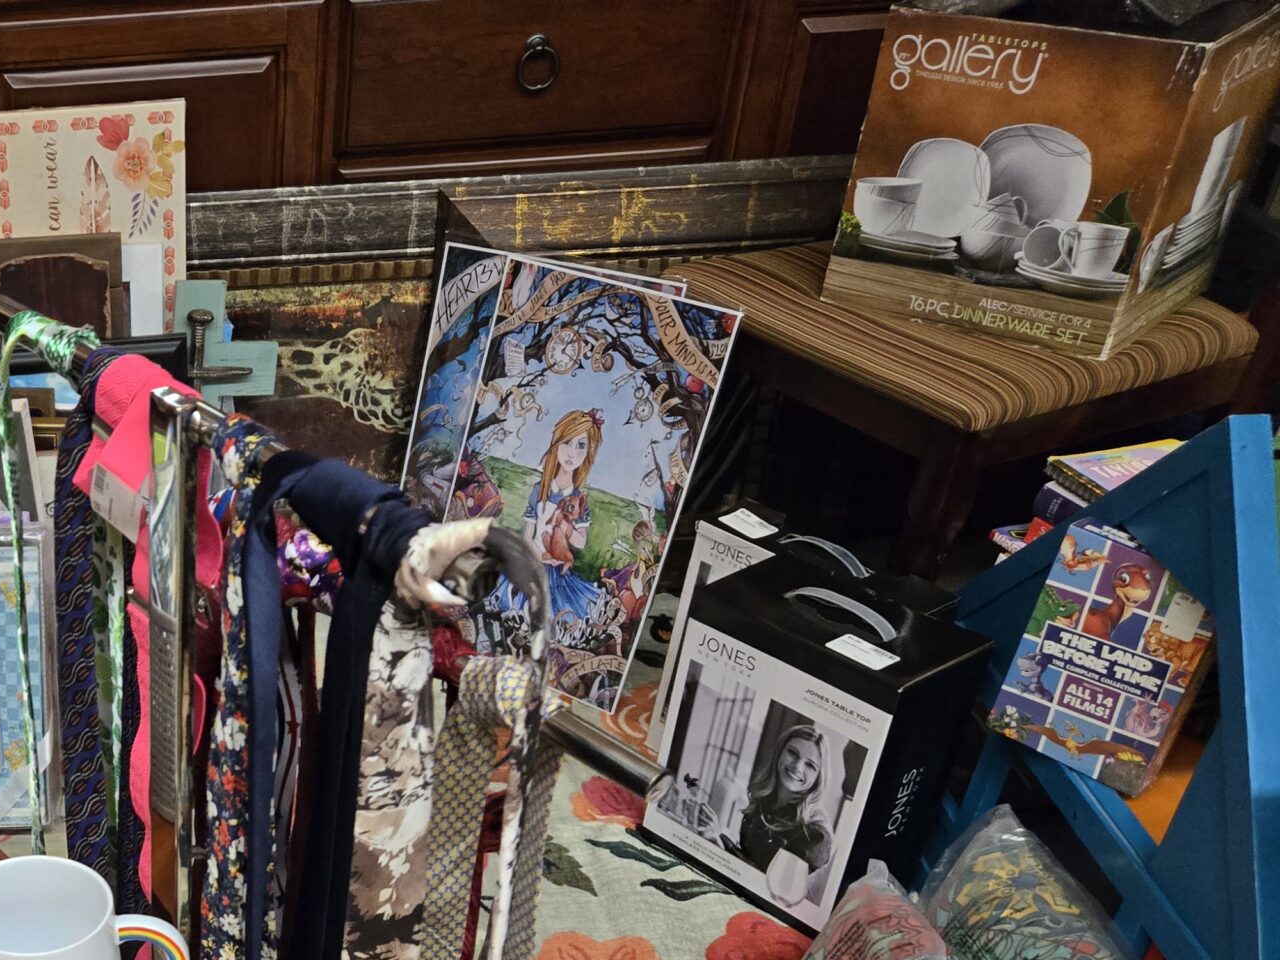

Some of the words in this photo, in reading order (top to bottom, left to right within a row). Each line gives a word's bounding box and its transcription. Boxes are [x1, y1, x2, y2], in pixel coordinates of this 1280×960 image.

[971, 33, 1048, 51] TABLETOPS
[890, 34, 1045, 95] gallery
[43, 137, 60, 191] wear
[46, 198, 63, 232] can
[1056, 328, 1088, 346] SET
[1058, 314, 1083, 328] FOR
[1083, 319, 1092, 329] 4
[668, 334, 699, 367] MIND
[710, 539, 753, 568] JONES
[698, 633, 757, 672] JONES
[1042, 640, 1111, 675] BEFORE
[1113, 665, 1162, 693] TIME
[1059, 631, 1097, 655] THE
[1101, 644, 1153, 672] LAND
[1052, 658, 1065, 668] THE
[1066, 662, 1100, 681] COMPLETE
[1100, 676, 1142, 696] COLLECTION
[805, 688, 830, 703] JONES
[831, 700, 855, 716] TABLE
[856, 712, 872, 724] TOP
[1063, 695, 1111, 719] FILMS!
[1066, 683, 1096, 700] ALL
[1097, 693, 1114, 709] 14
[884, 769, 918, 837] JONES
